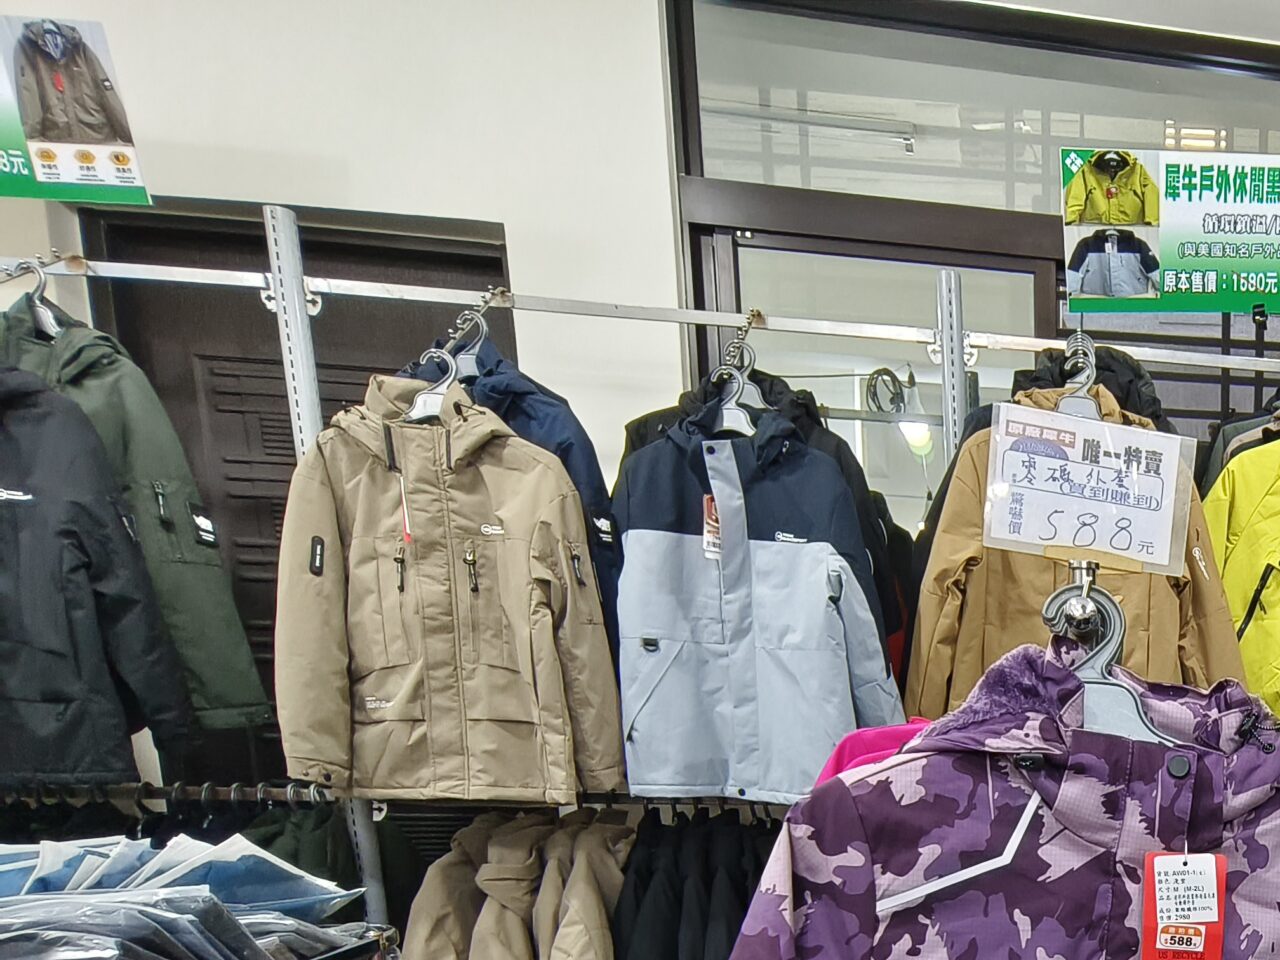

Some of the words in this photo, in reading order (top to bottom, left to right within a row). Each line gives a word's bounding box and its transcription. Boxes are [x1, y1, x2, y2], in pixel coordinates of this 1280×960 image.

[1039, 509, 1133, 551] 588
[1137, 540, 1155, 556] 元
[1169, 935, 1193, 947] 588
[1158, 950, 1169, 960] US
[1172, 951, 1206, 960] RECYCLE
